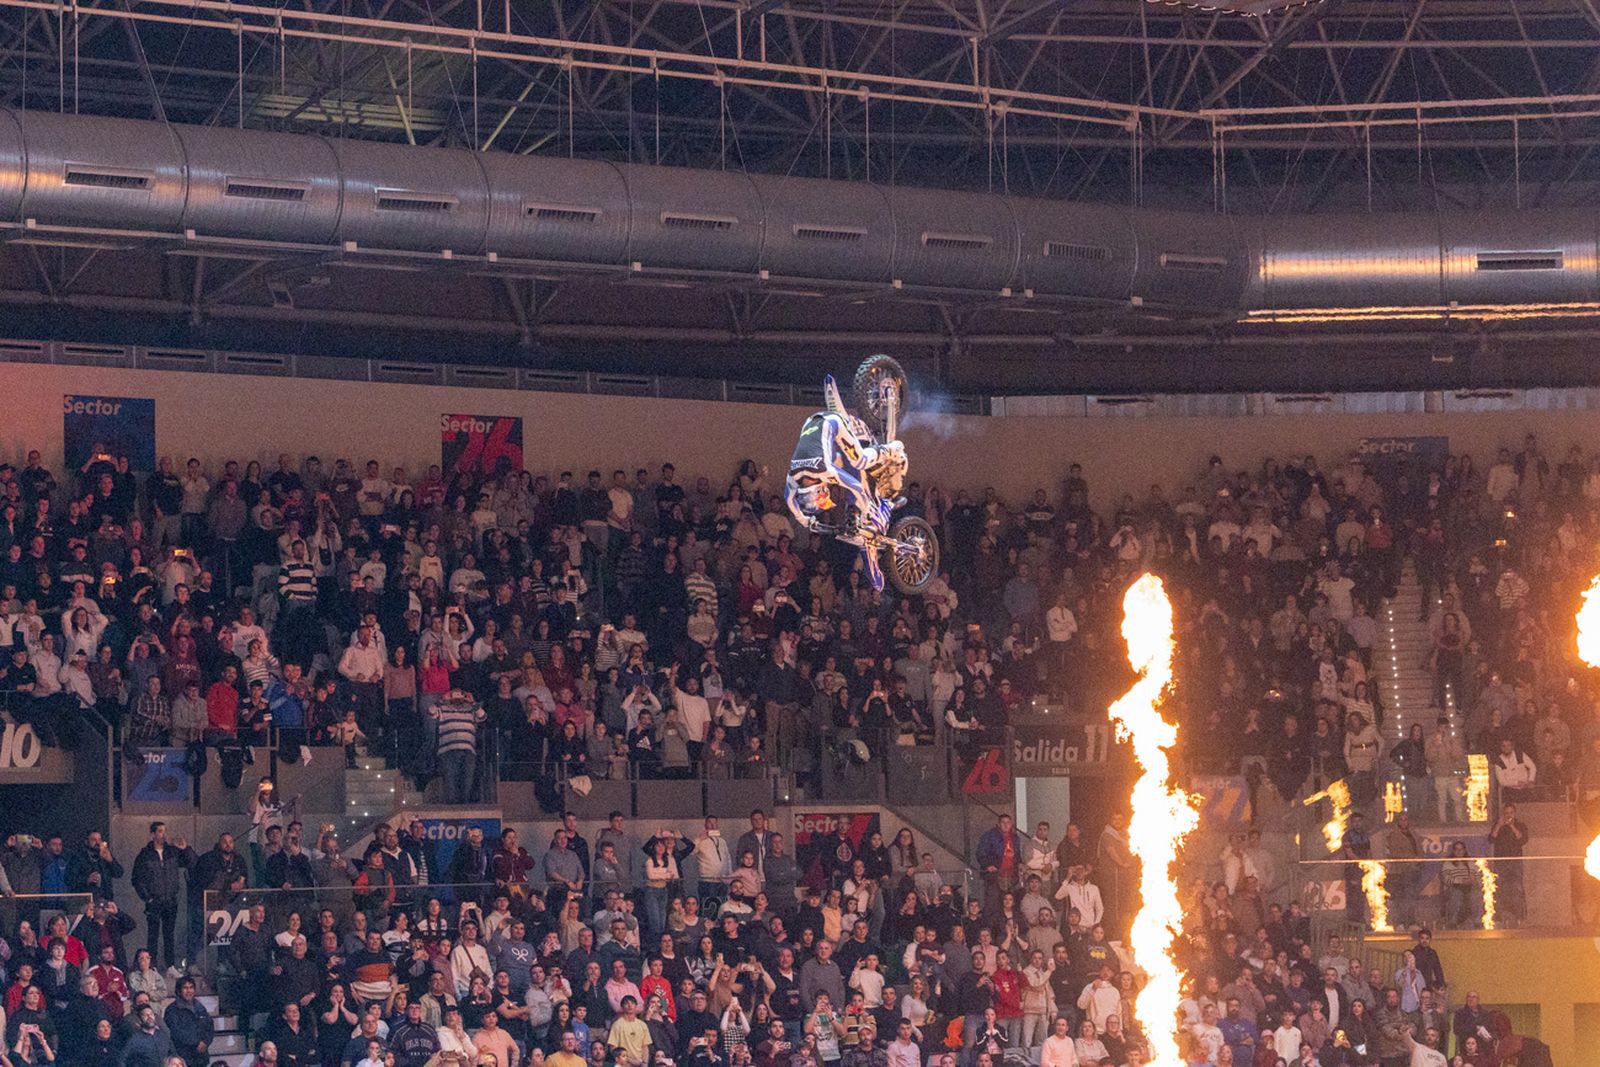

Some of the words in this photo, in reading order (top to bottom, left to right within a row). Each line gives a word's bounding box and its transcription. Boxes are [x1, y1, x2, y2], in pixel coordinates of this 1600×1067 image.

[64, 396, 122, 416] Sector
[441, 415, 494, 434] Sector
[1013, 739, 1079, 763] Salida
